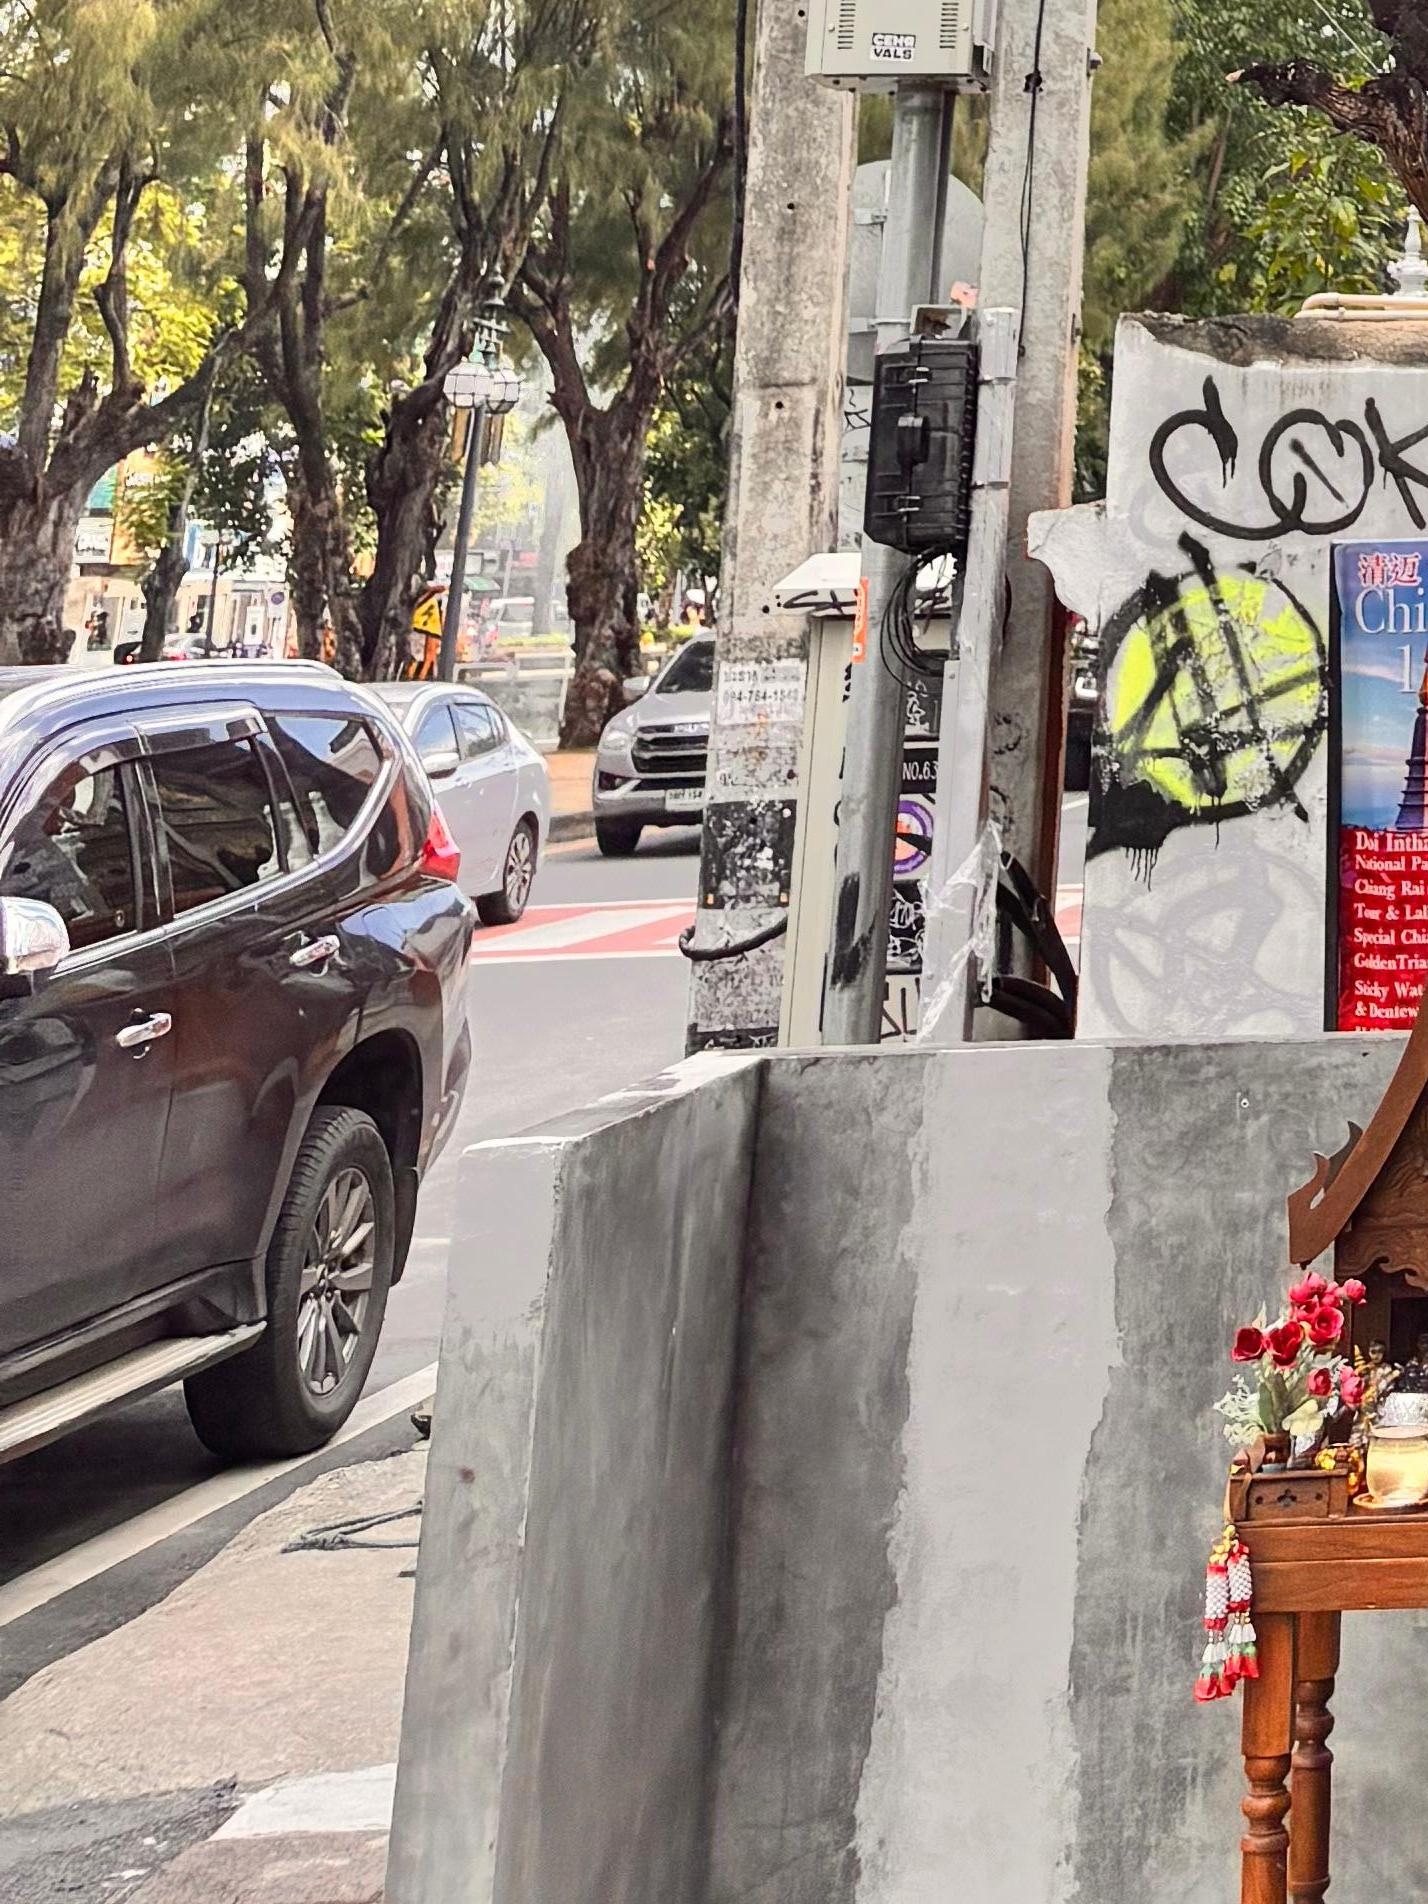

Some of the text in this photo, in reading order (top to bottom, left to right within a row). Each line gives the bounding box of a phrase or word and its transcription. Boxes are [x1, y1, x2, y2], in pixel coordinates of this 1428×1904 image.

[874, 48, 912, 60] VALS
[1398, 644, 1418, 693] 1
[1355, 831, 1381, 852] Doi
[1355, 853, 1406, 872] National
[1354, 879, 1396, 901] Chiang
[1401, 879, 1426, 897] Rai
[1385, 905, 1400, 921] &
[1354, 927, 1396, 948] Special
[1354, 979, 1390, 1003] Sticky
[1354, 1001, 1368, 1017] &
